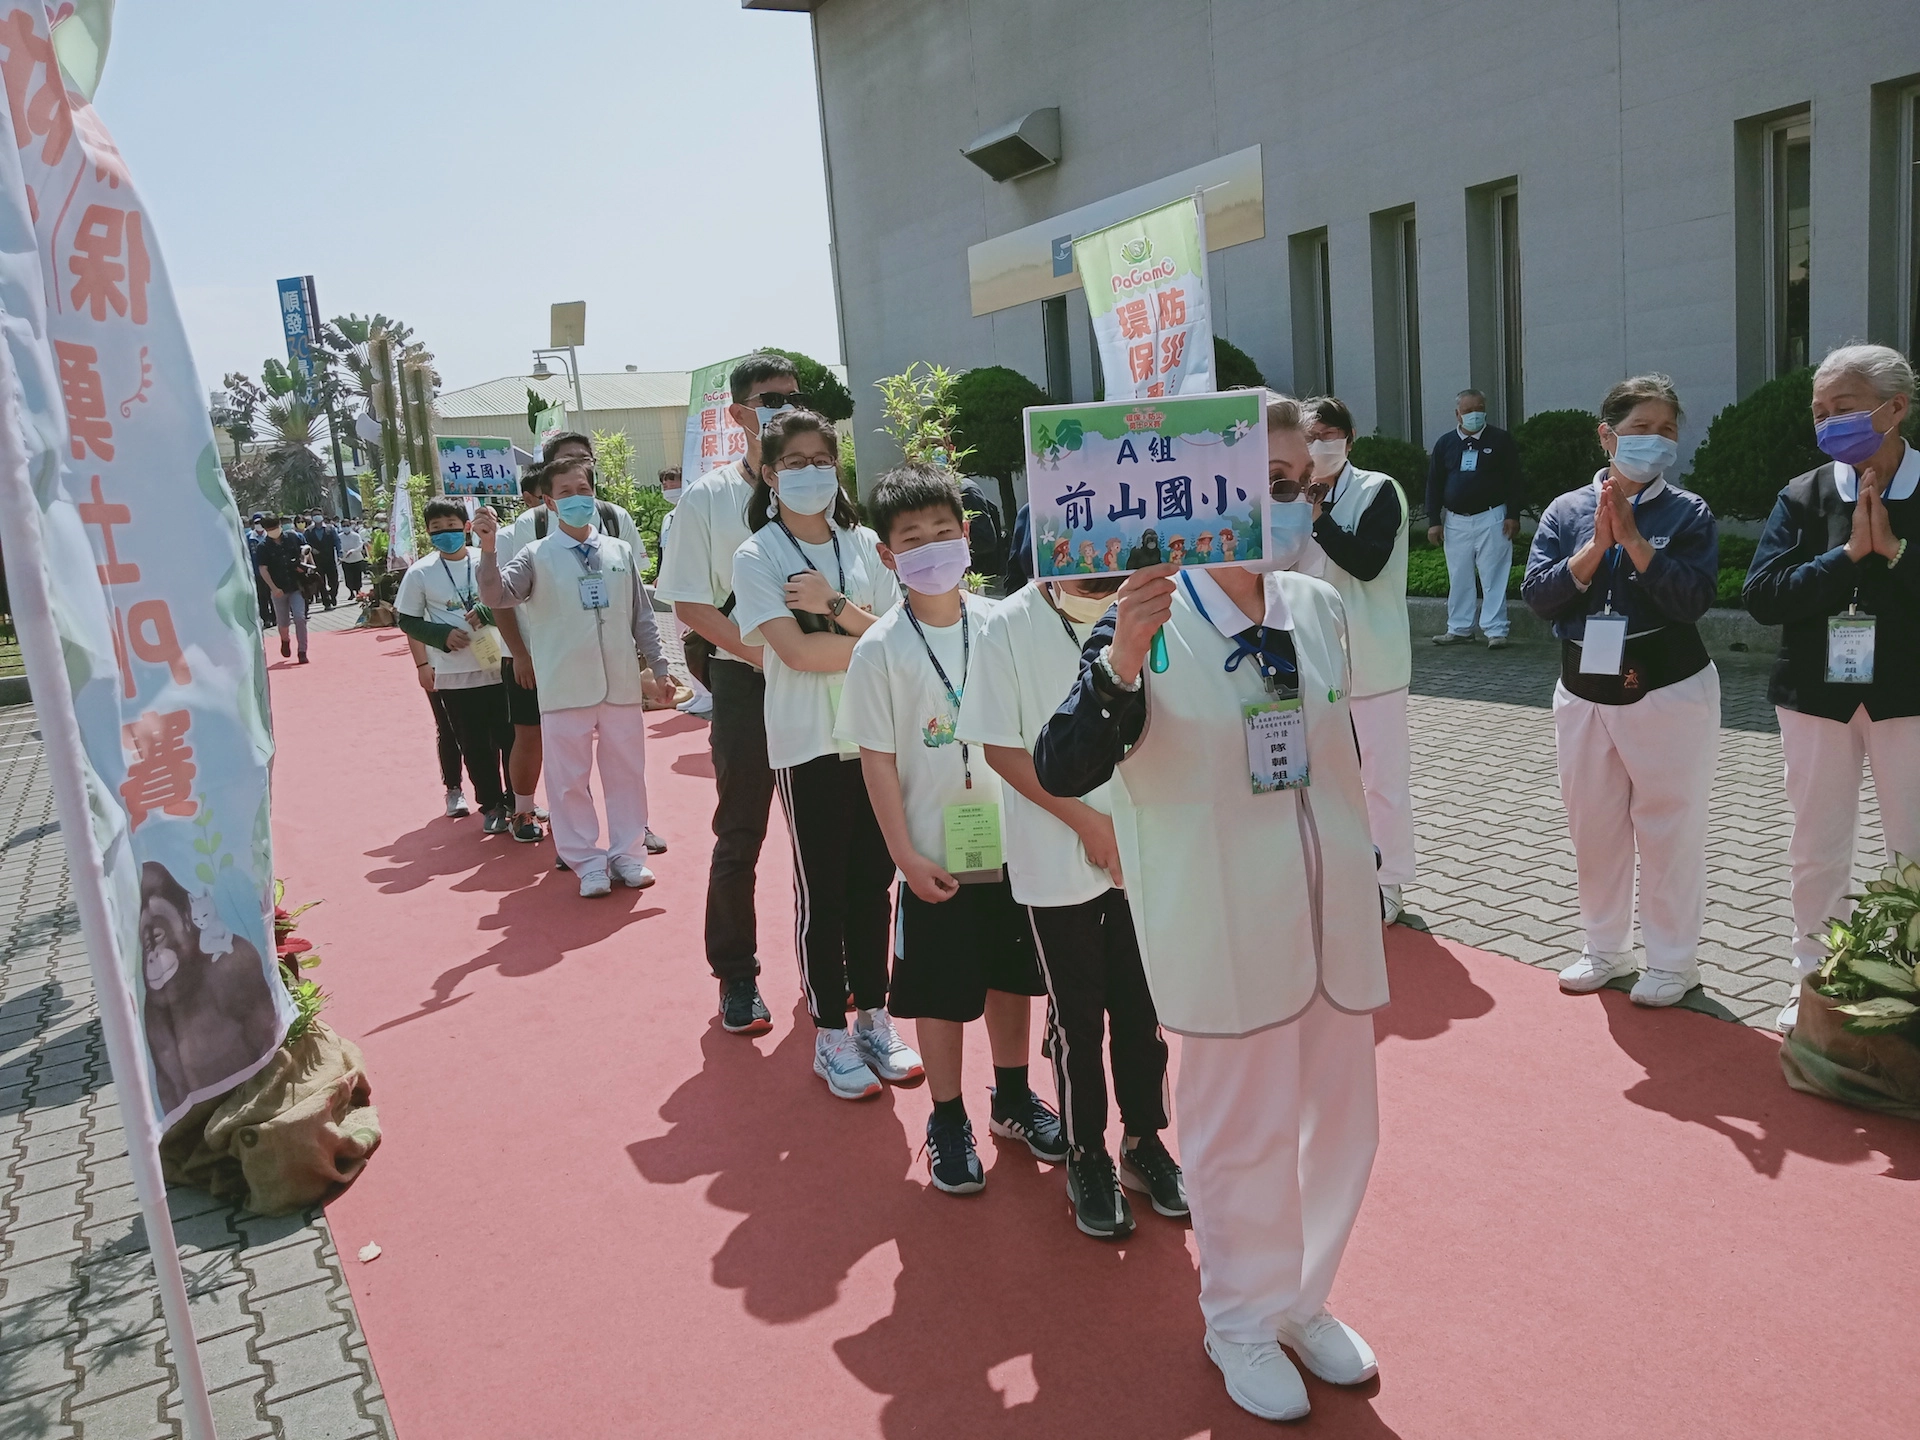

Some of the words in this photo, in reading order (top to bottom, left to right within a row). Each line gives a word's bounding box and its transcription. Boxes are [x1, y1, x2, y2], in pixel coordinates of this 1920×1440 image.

[1116, 299, 1153, 383] 環保
[1158, 287, 1186, 373] 防災
[466, 449, 486, 459] B組
[701, 408, 718, 458] 環保
[1116, 436, 1176, 465] A組
[448, 461, 511, 480] 中正國小
[1055, 474, 1247, 532] 前山國小
